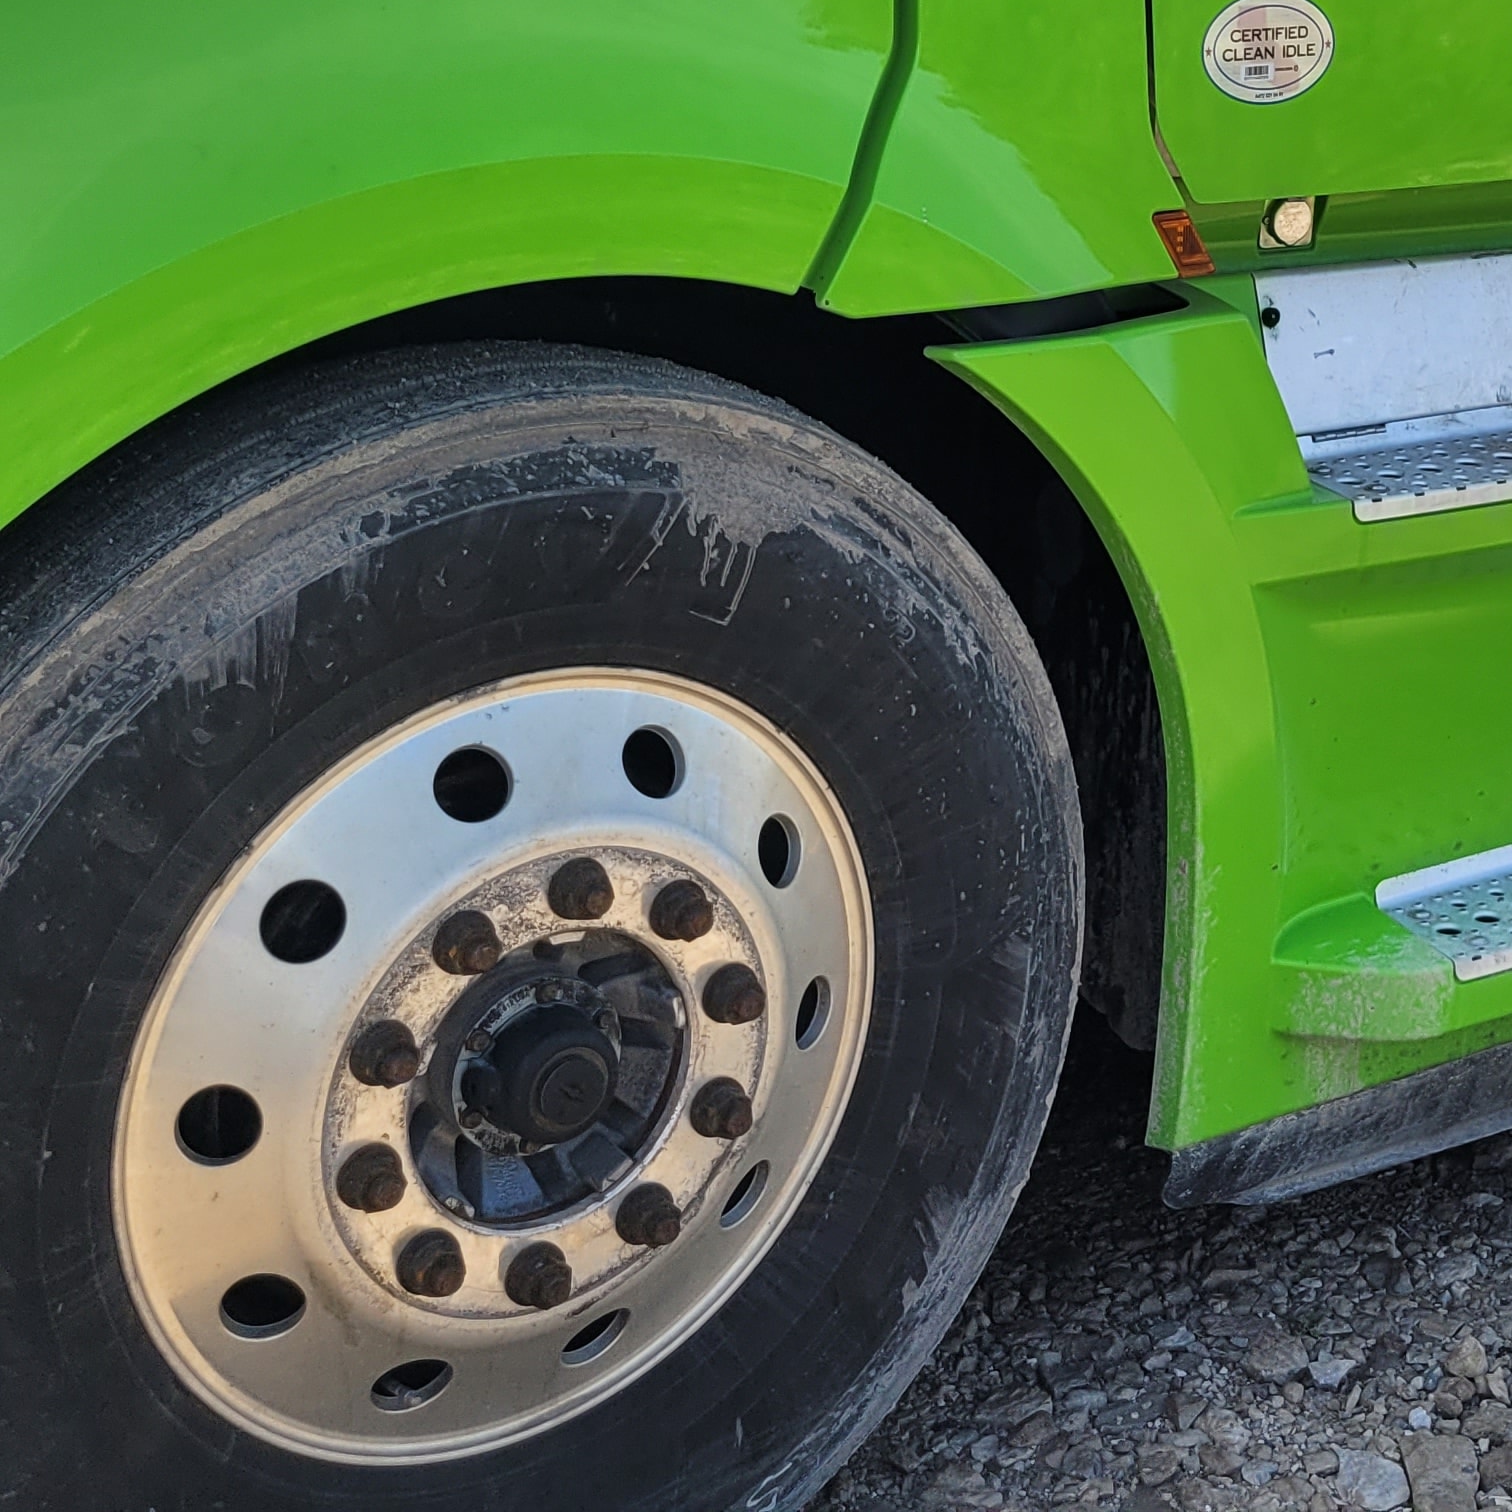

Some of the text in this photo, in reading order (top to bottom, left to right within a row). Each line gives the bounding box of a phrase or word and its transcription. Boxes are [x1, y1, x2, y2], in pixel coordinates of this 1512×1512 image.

[1230, 25, 1309, 43] CERTIFIED
[1222, 43, 1316, 62] CLEAN IDLE
